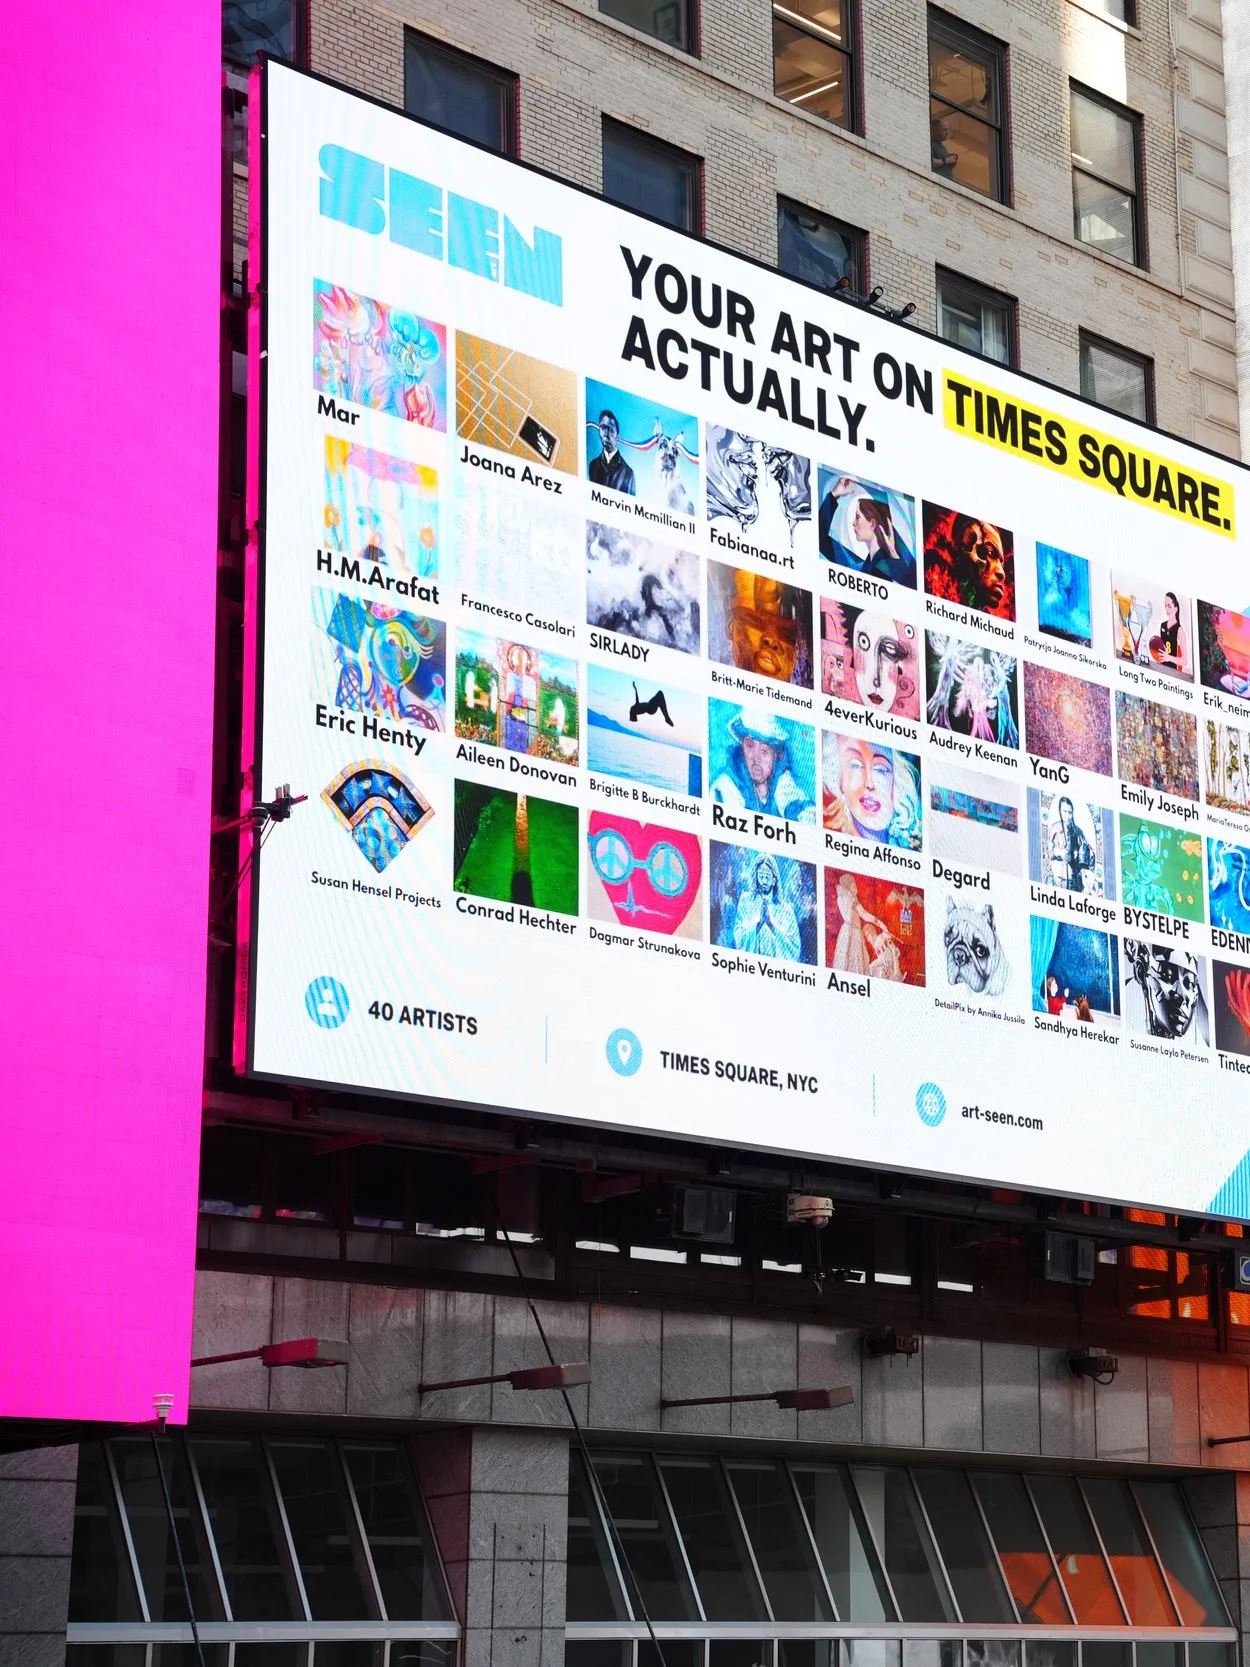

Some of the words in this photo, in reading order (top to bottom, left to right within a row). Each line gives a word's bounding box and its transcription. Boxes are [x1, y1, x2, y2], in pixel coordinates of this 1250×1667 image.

[319, 143, 562, 307] SEEN
[620, 245, 754, 344] YOUR
[770, 310, 859, 384] ART
[874, 353, 933, 415] ON
[947, 379, 1067, 465] TIMES
[1079, 433, 1230, 530] SQUARE.
[621, 316, 874, 452] ACTUALLY.
[317, 395, 360, 426] Mar
[460, 446, 515, 478] Joana
[521, 466, 562, 494] Arez
[591, 490, 632, 514] Marvin
[634, 504, 686, 532] Mcmillian
[710, 528, 794, 569] Fabianaa.rt
[316, 549, 439, 604] H.M.Arafat
[829, 568, 888, 600] ROBERTO
[461, 594, 522, 622] Francesco
[526, 613, 576, 638] Casolari
[926, 600, 968, 625] Richard
[970, 616, 1014, 640] Michaud
[590, 632, 650, 662] SIRLADY
[1024, 636, 1052, 652] Patrycja
[1054, 646, 1077, 660] Joanna
[1079, 654, 1106, 670] Sikorska
[712, 671, 764, 696] Britt-Marie
[766, 686, 812, 710] Tidemand
[1119, 666, 1138, 684] Long
[1140, 673, 1156, 686] Two
[1158, 679, 1194, 700] Paintings
[316, 704, 356, 734] Eric
[363, 716, 426, 756] Henty
[824, 700, 918, 740] 4everKurious
[456, 744, 505, 770] Aileen
[510, 756, 577, 788] Donovan
[929, 731, 972, 756] Audrey
[975, 744, 1018, 768] Keenan
[1030, 757, 1070, 784] YanG
[590, 778, 630, 800] Brigitte
[632, 788, 639, 800] B
[642, 791, 700, 816] Burckhardt
[1121, 784, 1154, 812] Emily
[1158, 795, 1200, 822] Joseph
[712, 804, 748, 832] Raz
[754, 815, 796, 844] Forh
[826, 834, 870, 858] Regina
[872, 848, 921, 870] Affonso
[312, 871, 348, 890] Susan
[352, 879, 392, 899] Hensel
[396, 888, 442, 908] Projects
[932, 858, 990, 890] Degard
[456, 897, 514, 924] Conrad
[519, 908, 576, 936] Hechter
[1030, 886, 1066, 908] Linda
[1069, 895, 1116, 923] Laforge
[1124, 906, 1190, 940] BYSTELPE
[590, 927, 634, 948] Dagmar
[638, 936, 700, 960] Strunakova
[712, 953, 756, 978] Sophie
[758, 962, 816, 988] Venturini
[828, 972, 871, 998] Ansel
[368, 1000, 394, 1022] 40
[399, 1004, 478, 1036] ARTISTS
[934, 998, 966, 1014] DetailPix
[967, 1006, 976, 1016] by
[978, 1007, 1002, 1020] Annika
[1034, 1016, 1078, 1038] Sandhya
[1081, 1026, 1120, 1046] Herekar
[1130, 1039, 1158, 1054] Susanne
[1160, 1045, 1179, 1060] Layla
[1180, 1049, 1209, 1064] Petersen
[660, 1050, 710, 1076] TIMES
[714, 1060, 783, 1091] SQUARE,
[787, 1072, 818, 1094] NYC
[961, 1102, 1044, 1132] art-seen.com
